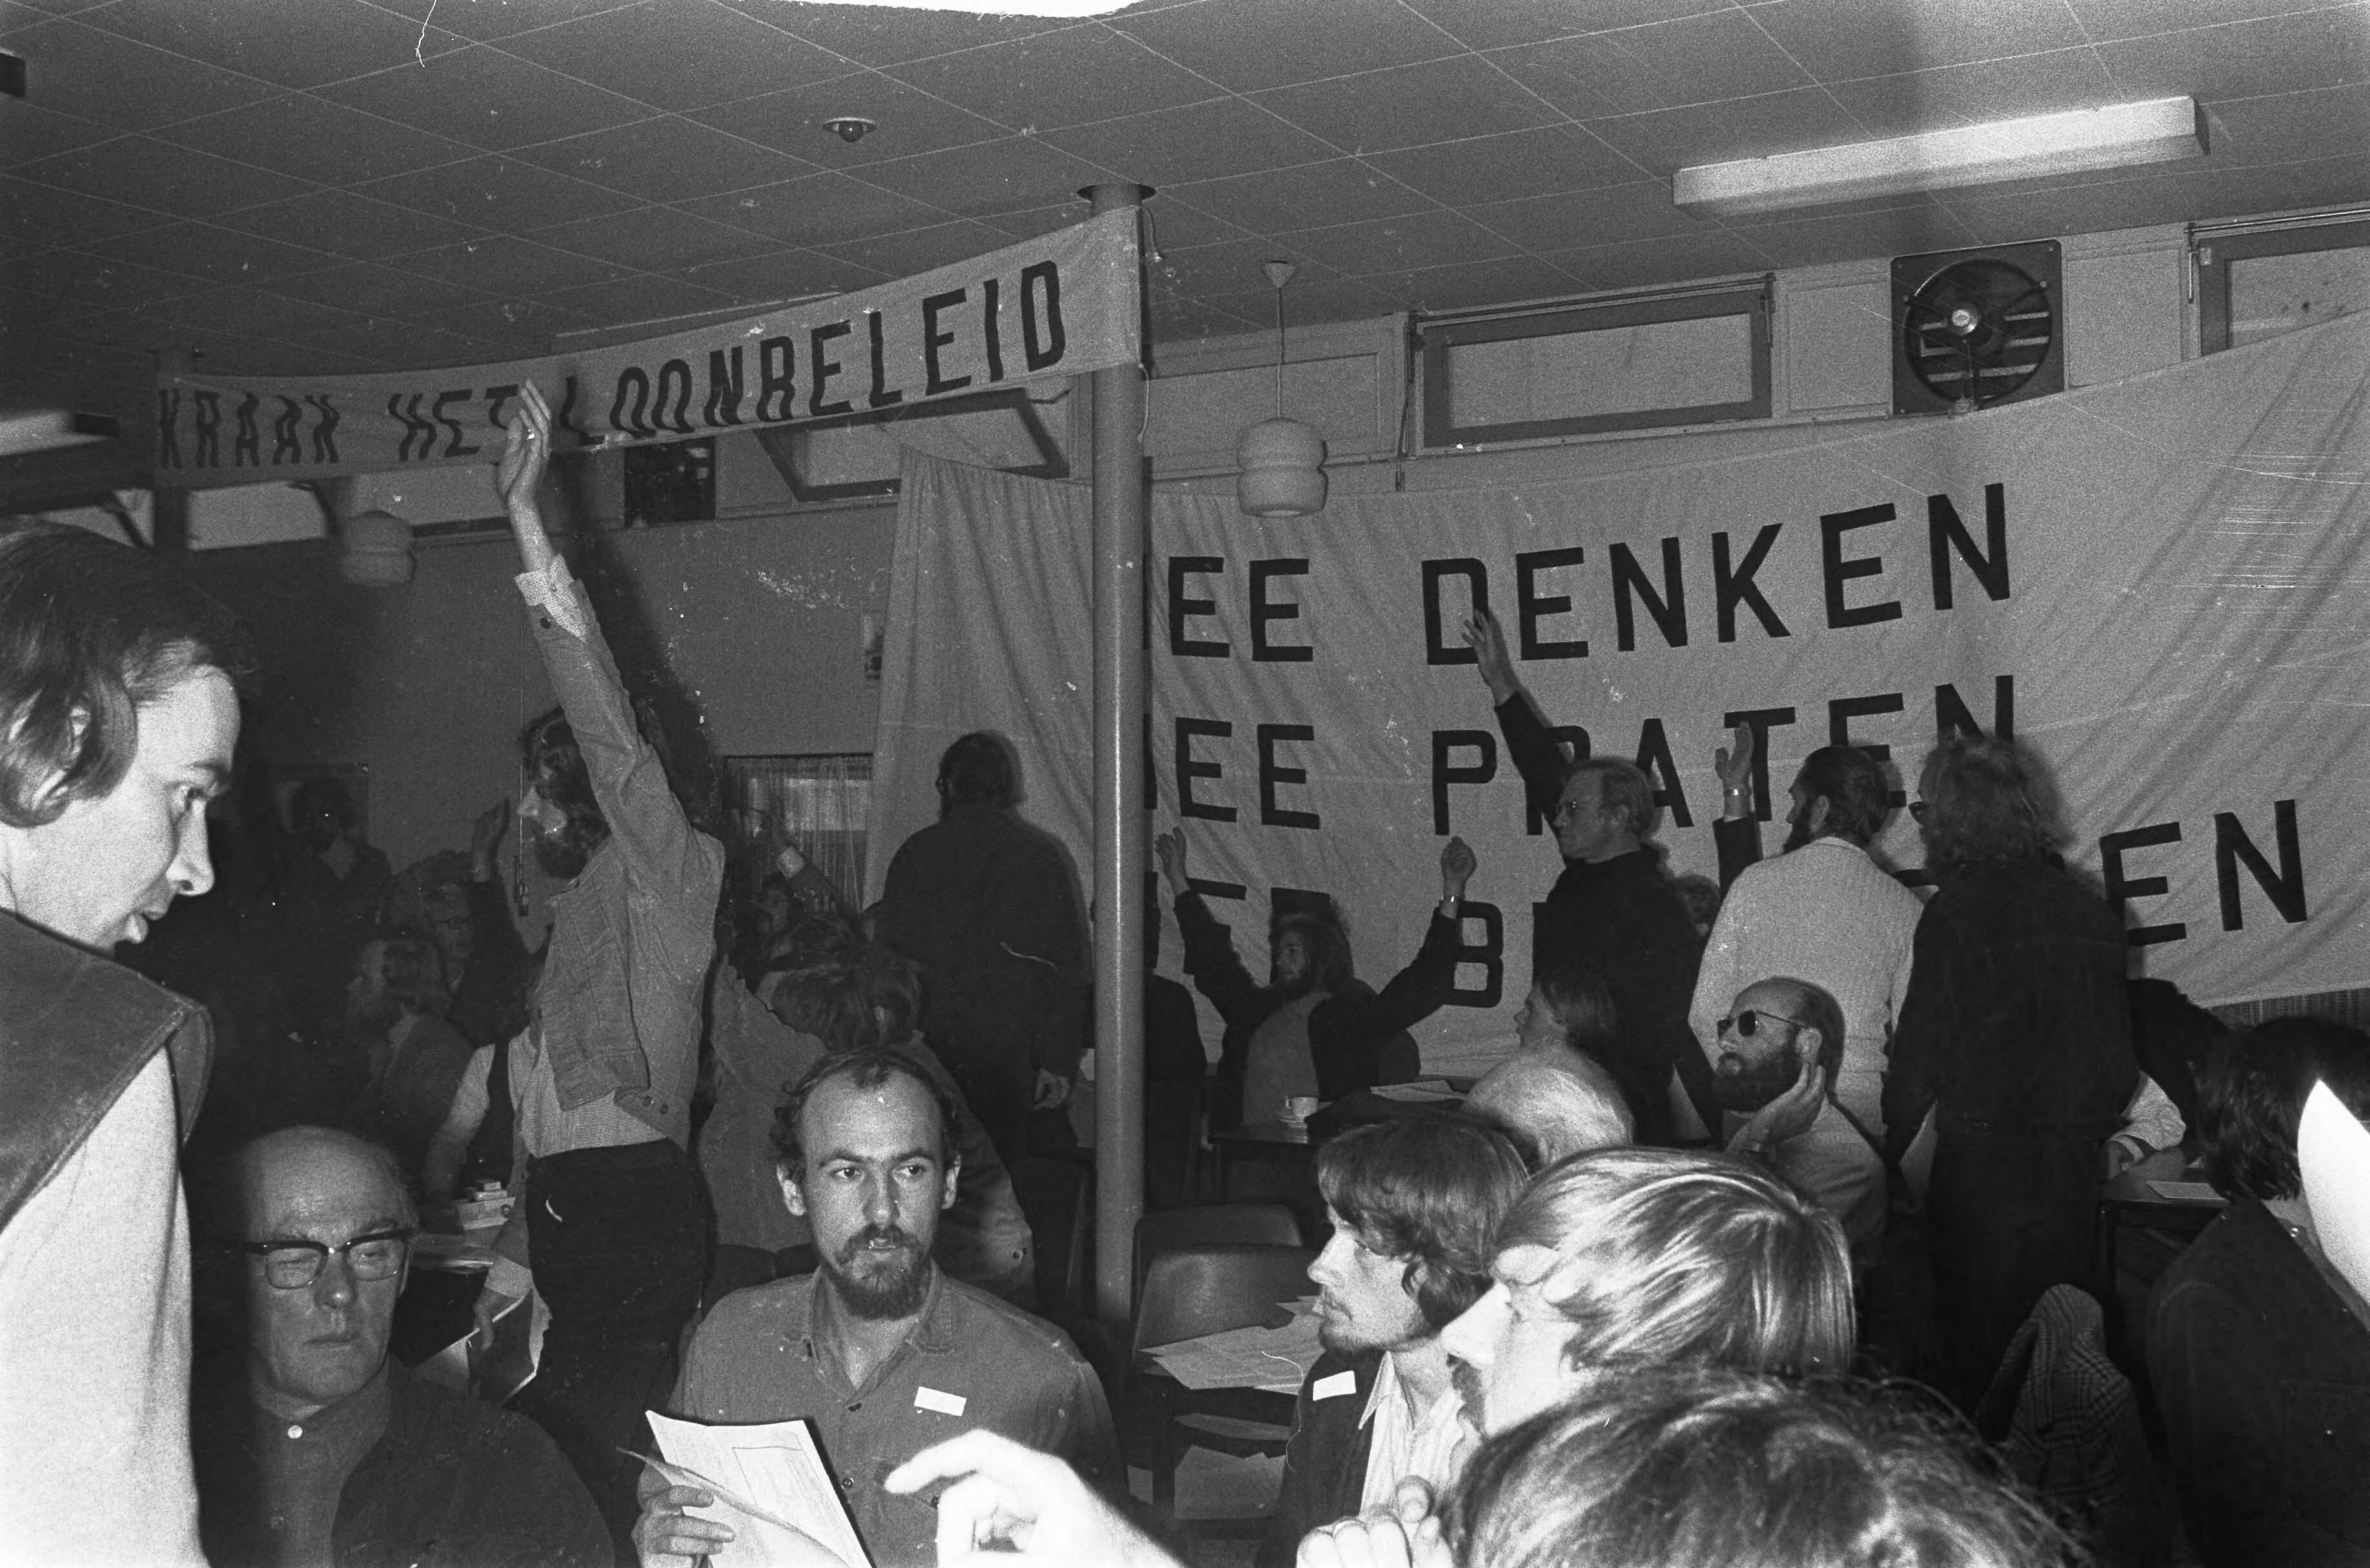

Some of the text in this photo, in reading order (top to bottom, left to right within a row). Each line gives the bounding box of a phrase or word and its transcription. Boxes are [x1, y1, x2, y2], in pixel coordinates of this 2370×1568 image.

[159, 388, 341, 468] KRAAK
[1144, 482, 2010, 665] EE DENKEN
[1144, 714, 1321, 830] EE
